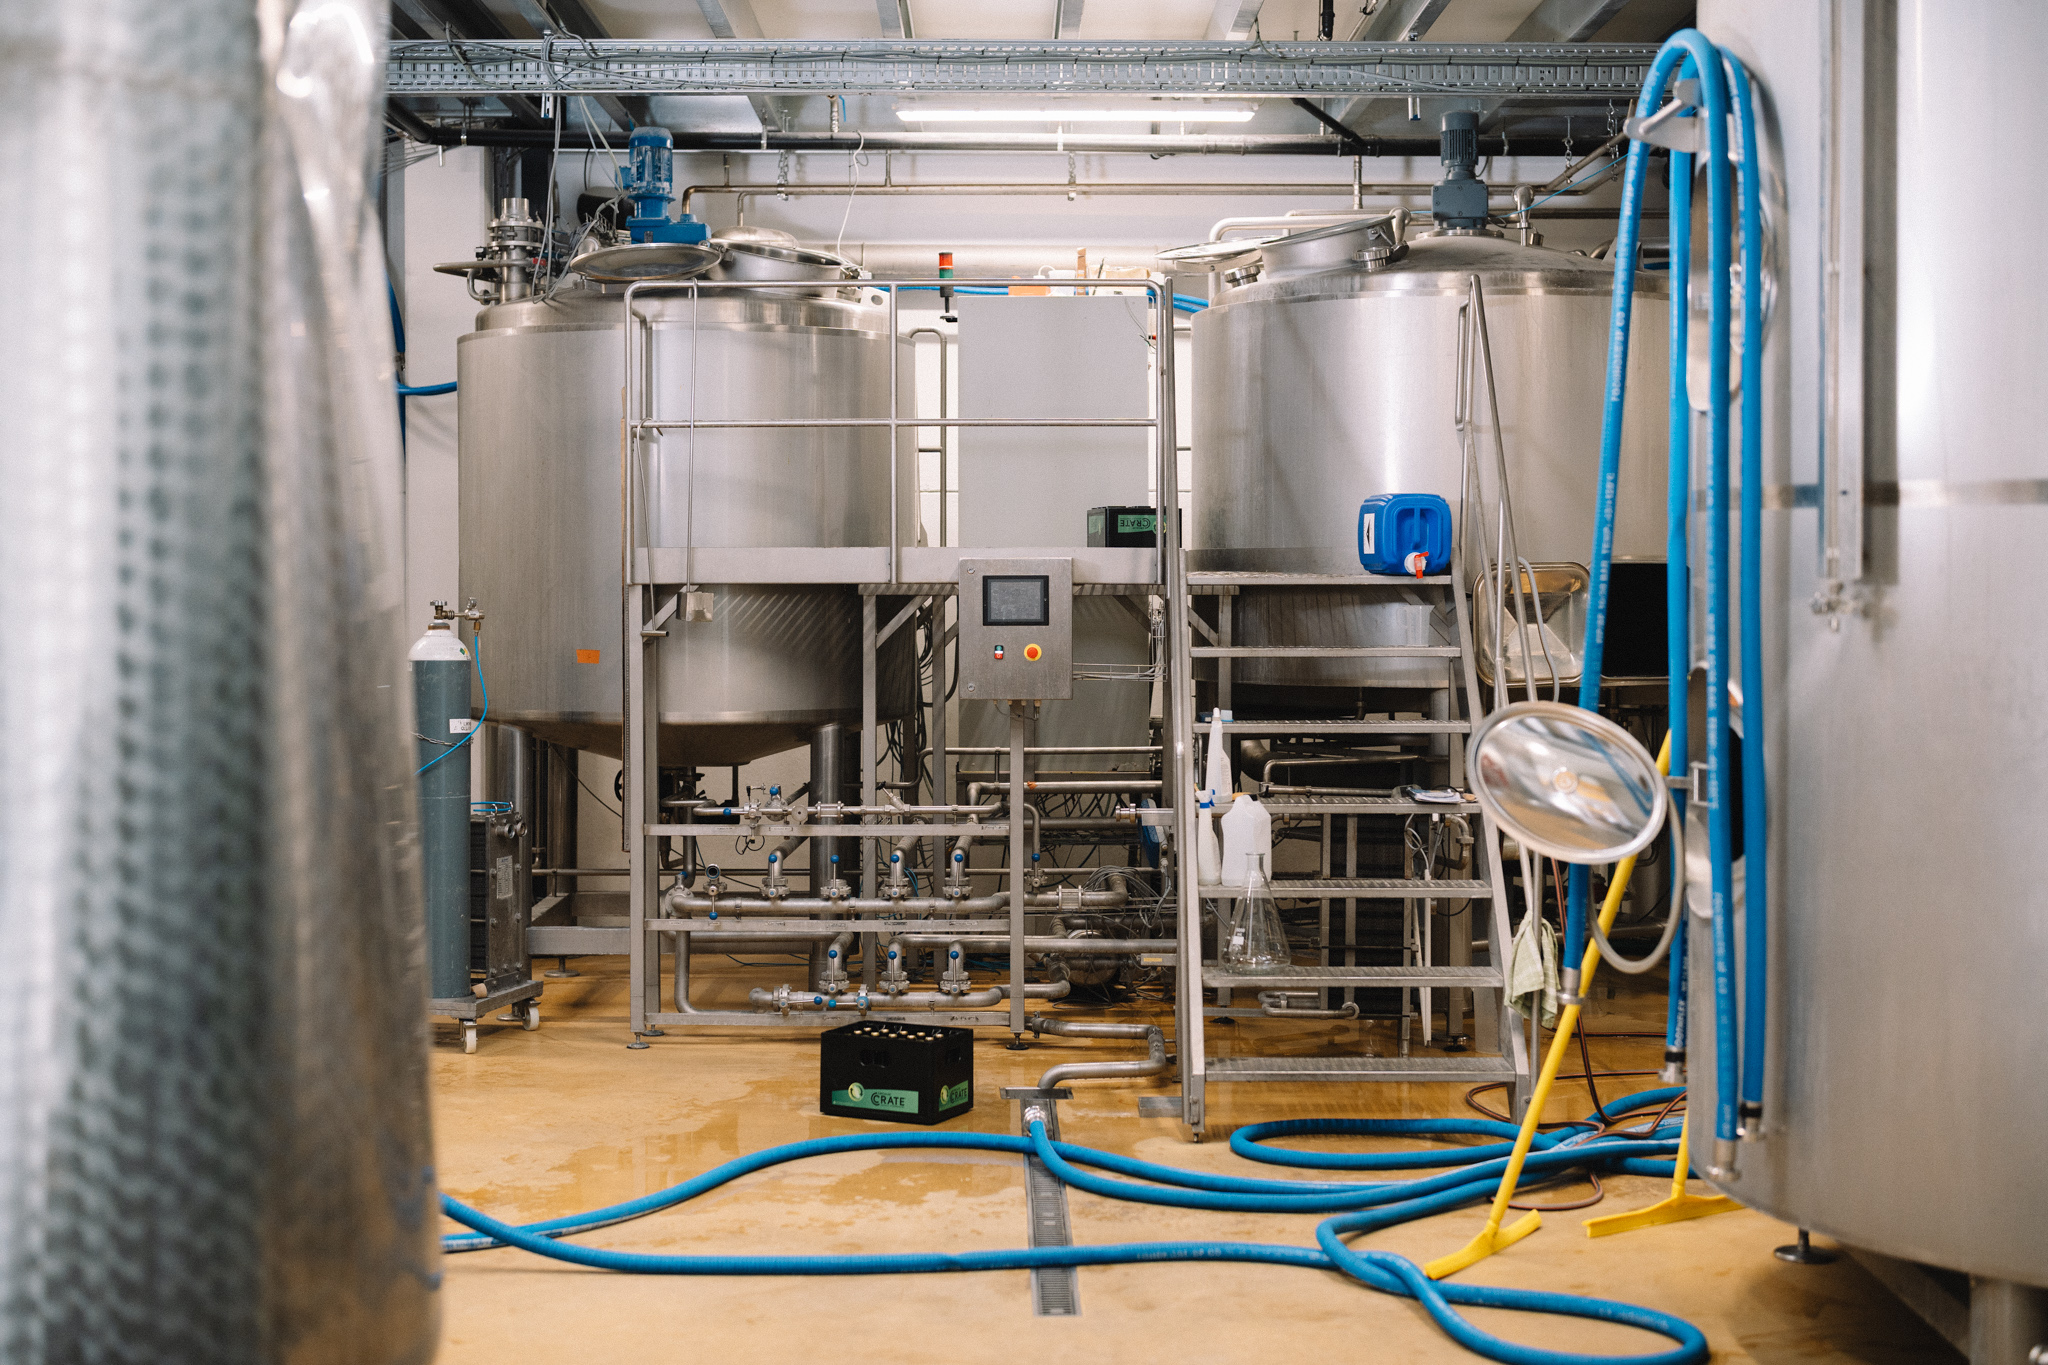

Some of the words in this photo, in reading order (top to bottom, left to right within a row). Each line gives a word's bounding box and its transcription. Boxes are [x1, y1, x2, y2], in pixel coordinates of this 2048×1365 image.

[1120, 518, 1150, 529] CRATE
[871, 1092, 905, 1106] CRATE
[950, 1088, 967, 1104] CRATE
